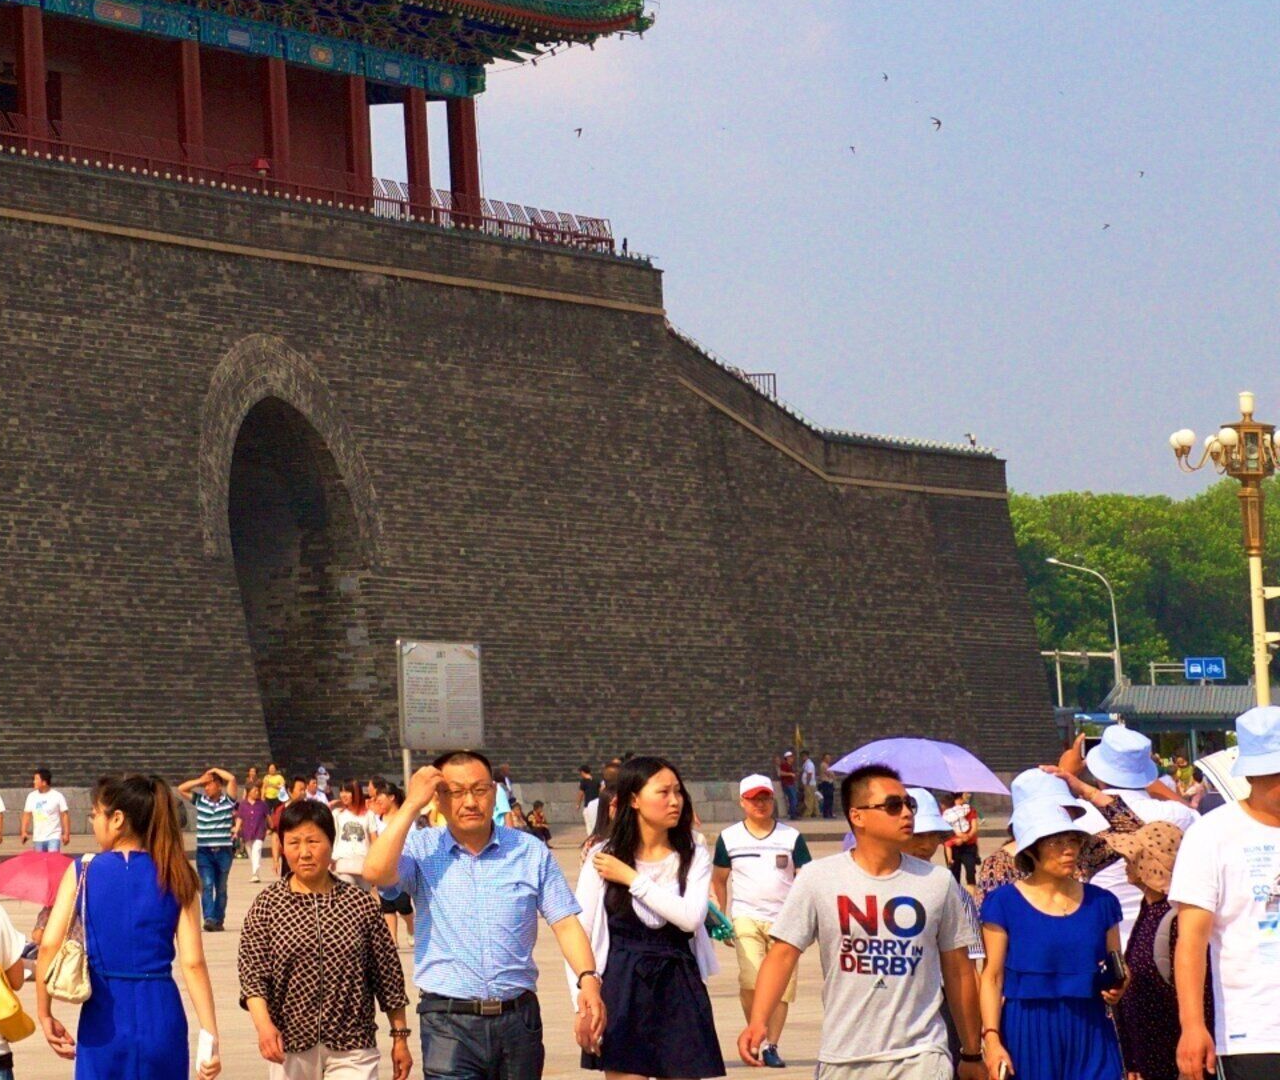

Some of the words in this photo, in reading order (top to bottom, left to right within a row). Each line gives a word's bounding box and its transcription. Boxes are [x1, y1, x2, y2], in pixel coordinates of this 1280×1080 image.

[837, 895, 927, 938] NO
[841, 938, 911, 955] SORRY
[911, 946, 923, 956] IN
[840, 954, 922, 976] DERBY
